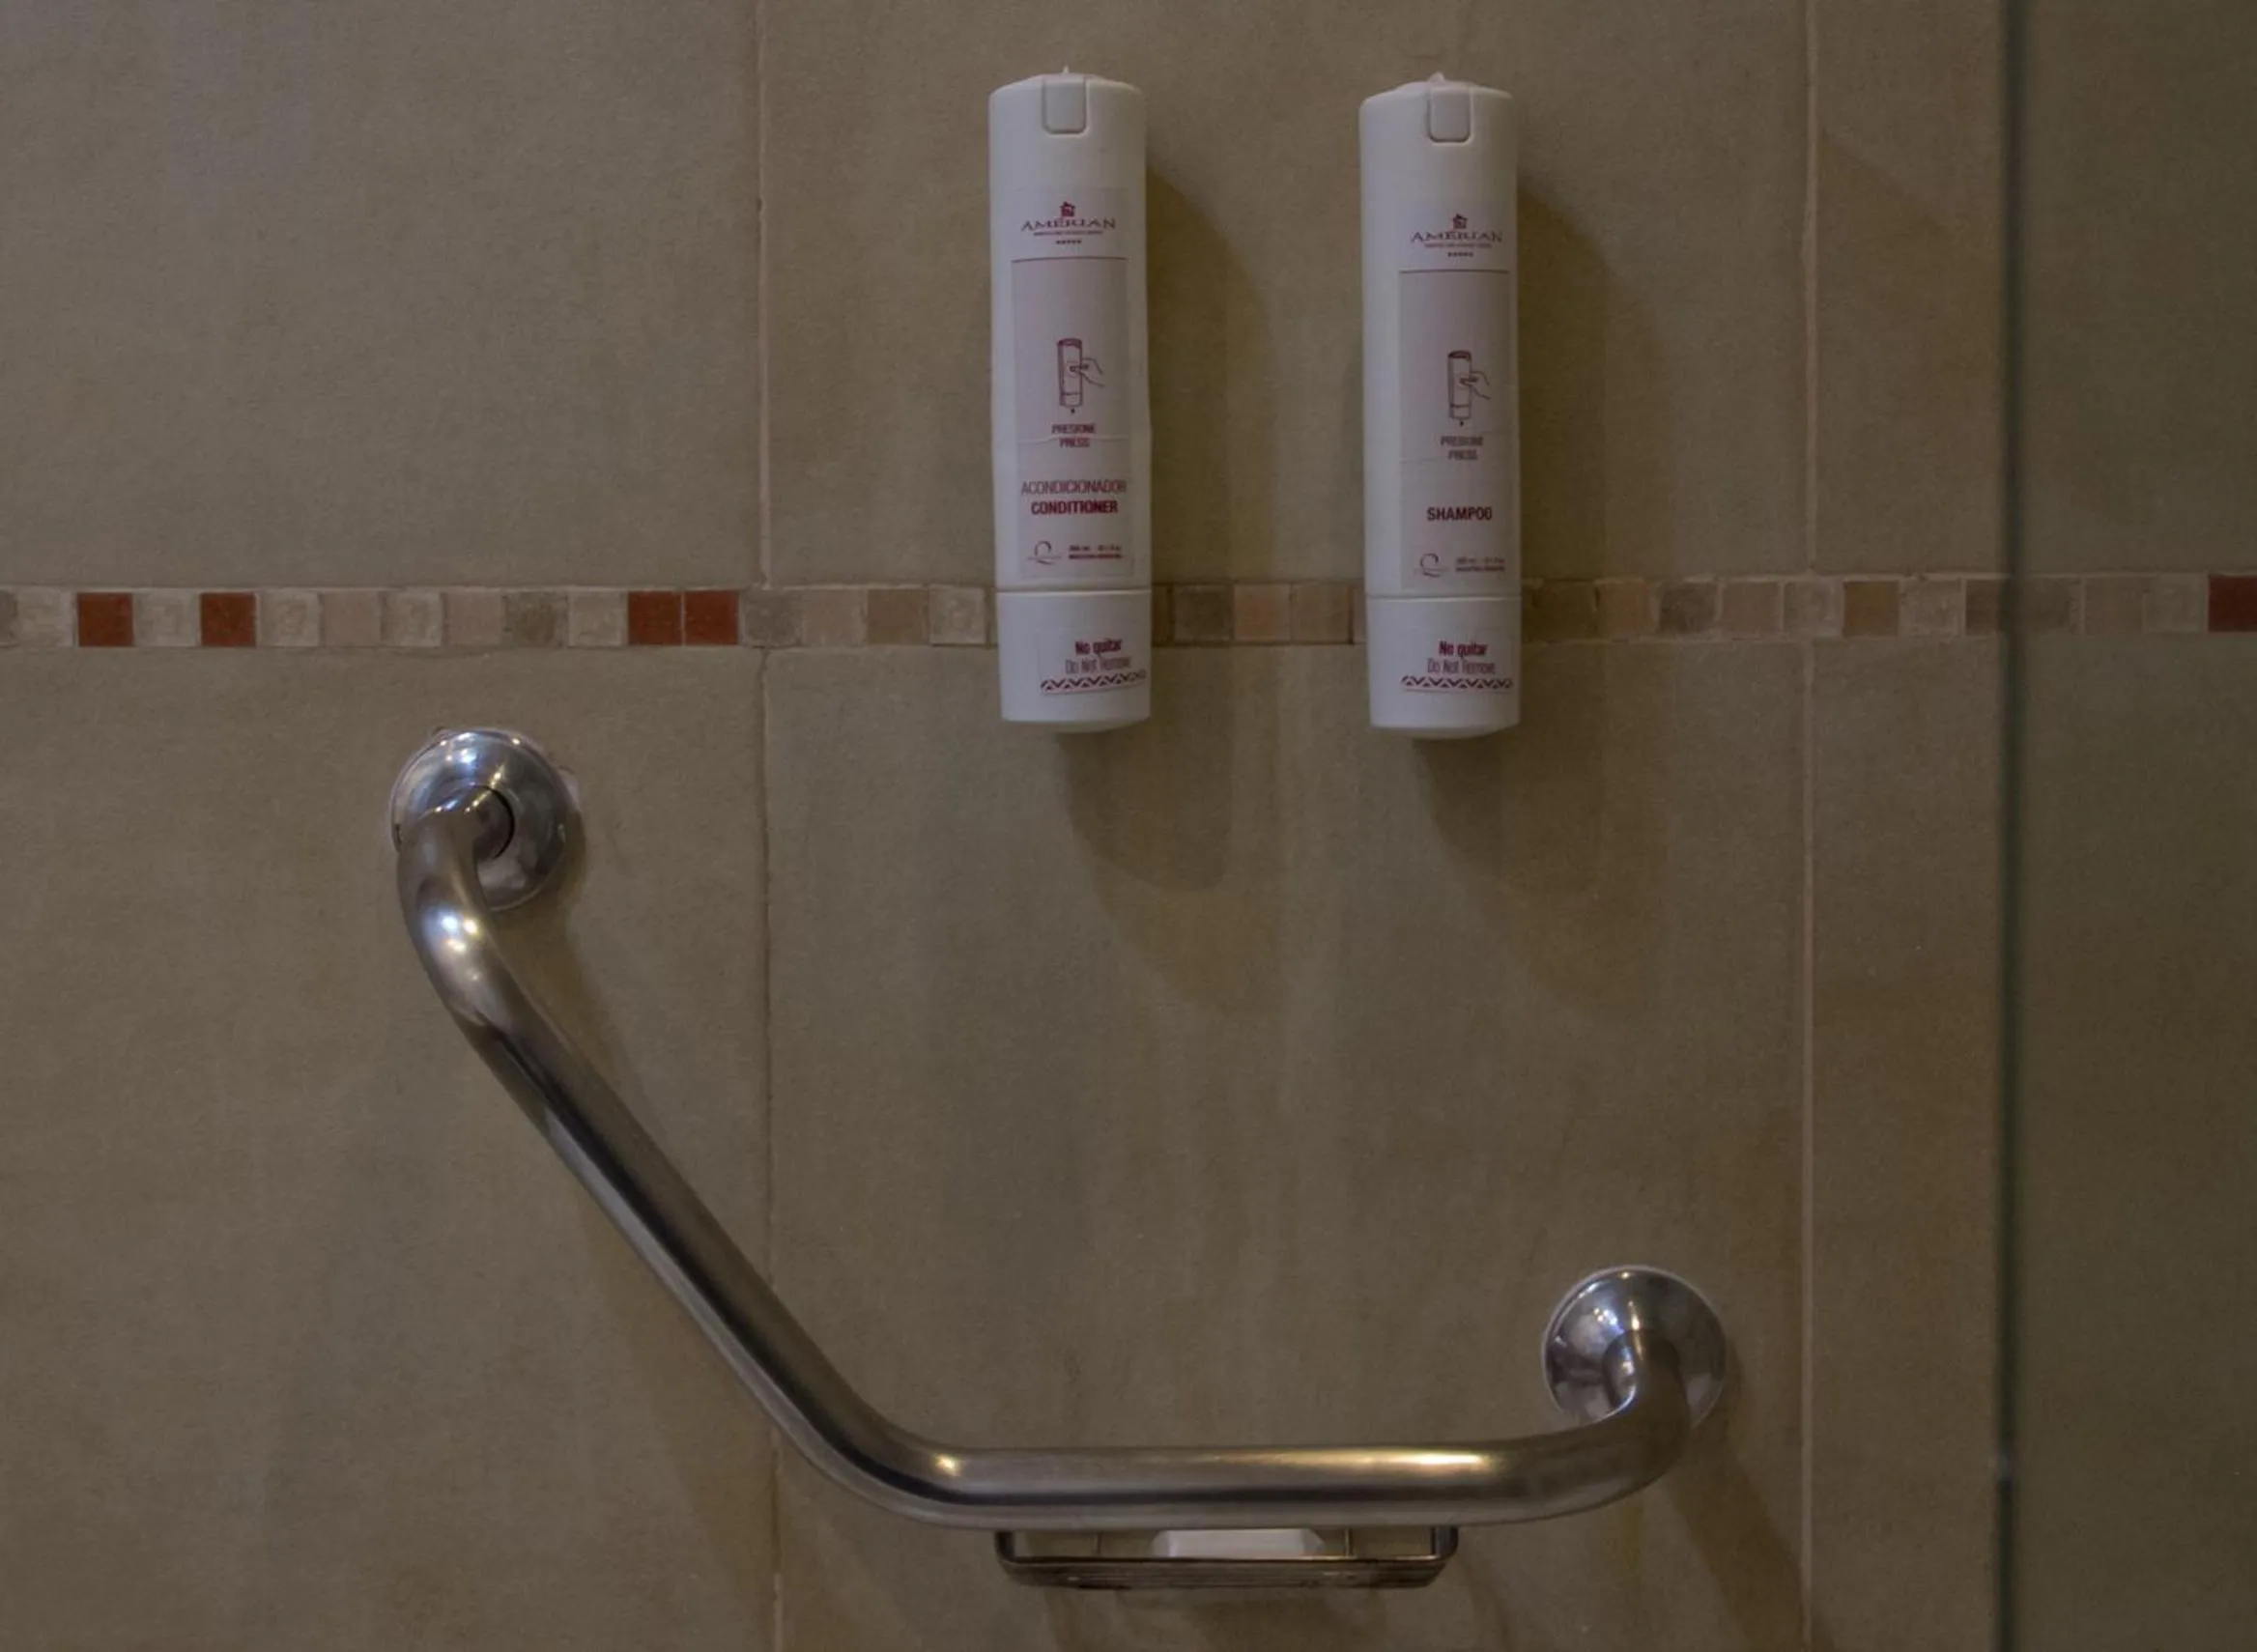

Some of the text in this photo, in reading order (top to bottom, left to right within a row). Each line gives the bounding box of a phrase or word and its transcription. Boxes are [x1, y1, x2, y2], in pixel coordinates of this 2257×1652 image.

[1021, 218, 1116, 231] AMERIAN
[1411, 232, 1502, 242] AMERIAN
[1020, 479, 1127, 495] ACONDICIONADOR
[1031, 499, 1118, 515] CONDITIONER
[1426, 506, 1493, 522] SHAMPOO
[1075, 639, 1123, 657] No quitar
[1439, 641, 1488, 658] No quitar
[1066, 660, 1079, 673] Do
[1427, 658, 1442, 673] Do
[1443, 660, 1458, 673] Not
